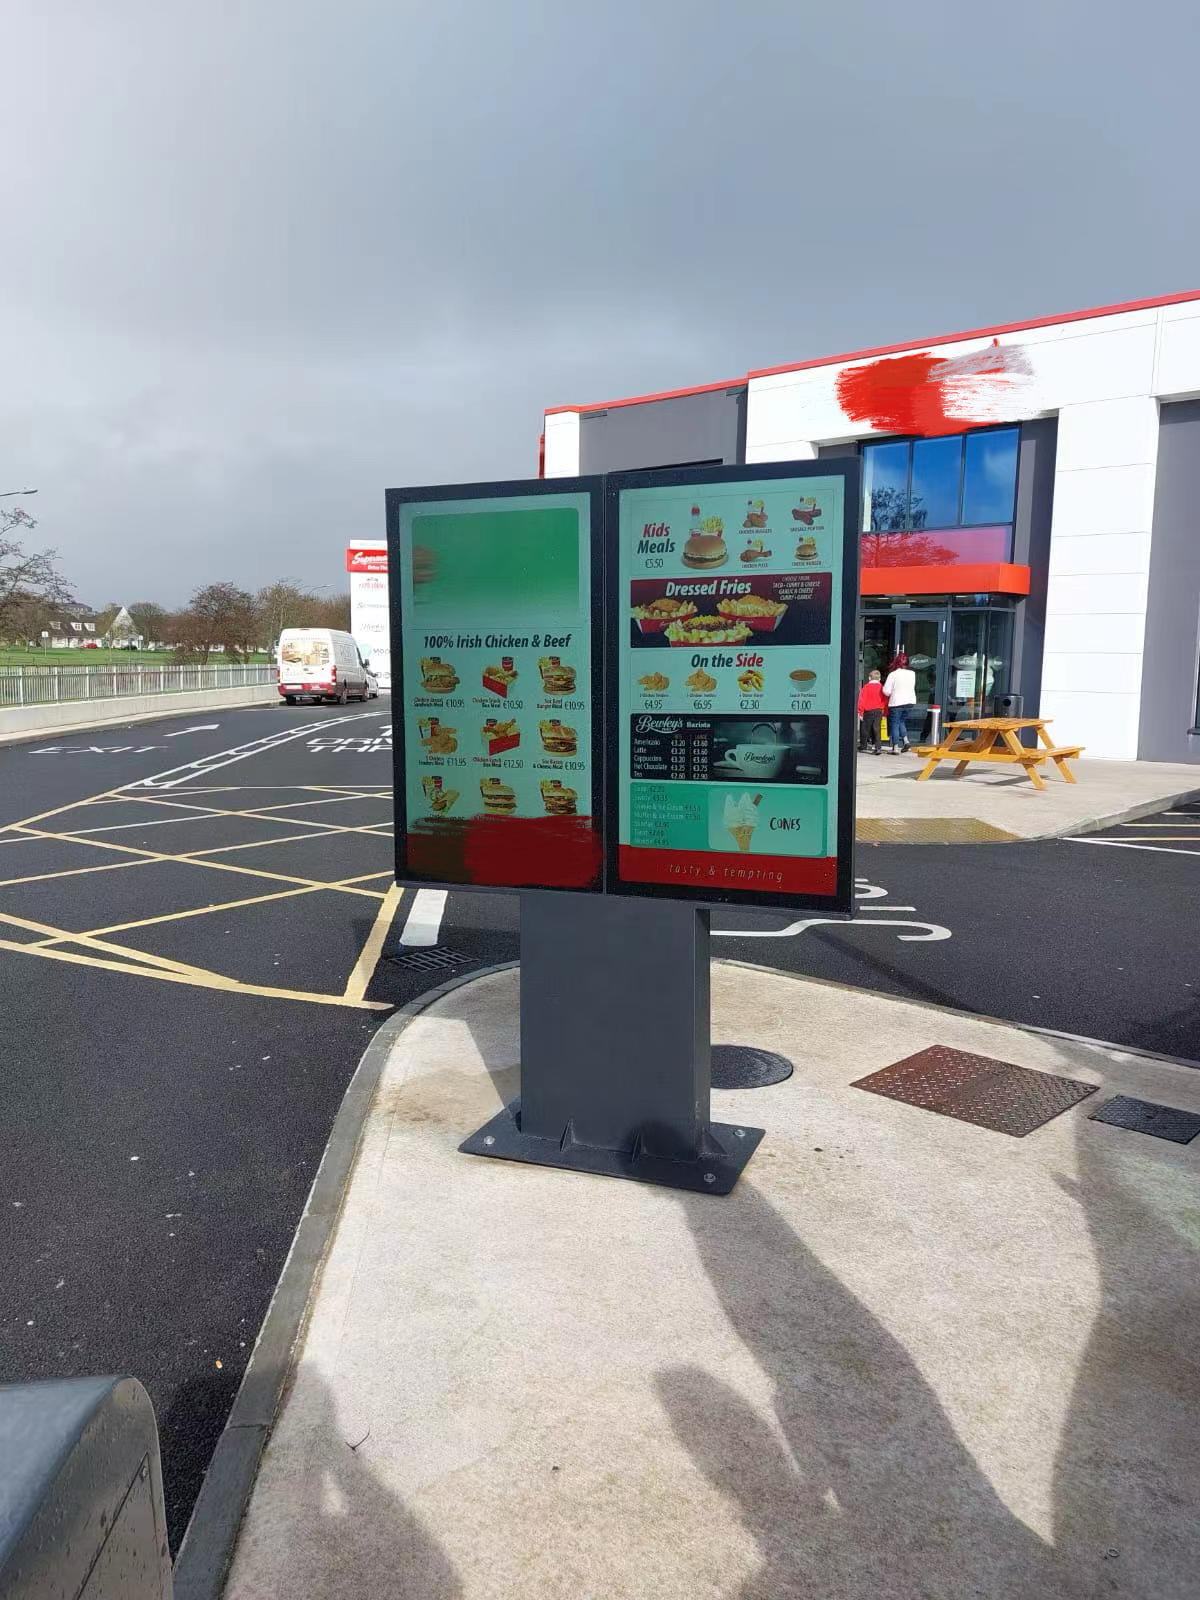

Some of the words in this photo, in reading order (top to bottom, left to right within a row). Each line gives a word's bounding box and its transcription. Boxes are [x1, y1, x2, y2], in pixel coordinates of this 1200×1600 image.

[642, 522, 670, 538] Kids
[637, 538, 676, 554] Meals
[645, 558, 664, 569] €5.50
[665, 580, 716, 597] Dressed
[720, 579, 752, 595] Fries
[424, 635, 454, 648] 100%
[456, 634, 482, 648] Irish
[484, 634, 528, 648] Chicken
[532, 635, 540, 648] &
[543, 633, 572, 648] Beef
[691, 654, 708, 668] On
[710, 654, 734, 668] the
[736, 653, 764, 667] Side
[644, 699, 663, 710] €4.95
[694, 699, 712, 710] €6.95
[740, 700, 760, 710] €2.30
[791, 700, 811, 710] €1.00
[636, 714, 683, 732] Bewley's
[28, 746, 168, 754] EXIT
[504, 760, 524, 768] €12.50
[743, 752, 776, 764] Bewley's
[769, 817, 801, 831] CONES
[669, 864, 701, 876] tasty
[709, 866, 716, 875] &
[724, 868, 784, 883] tempting
